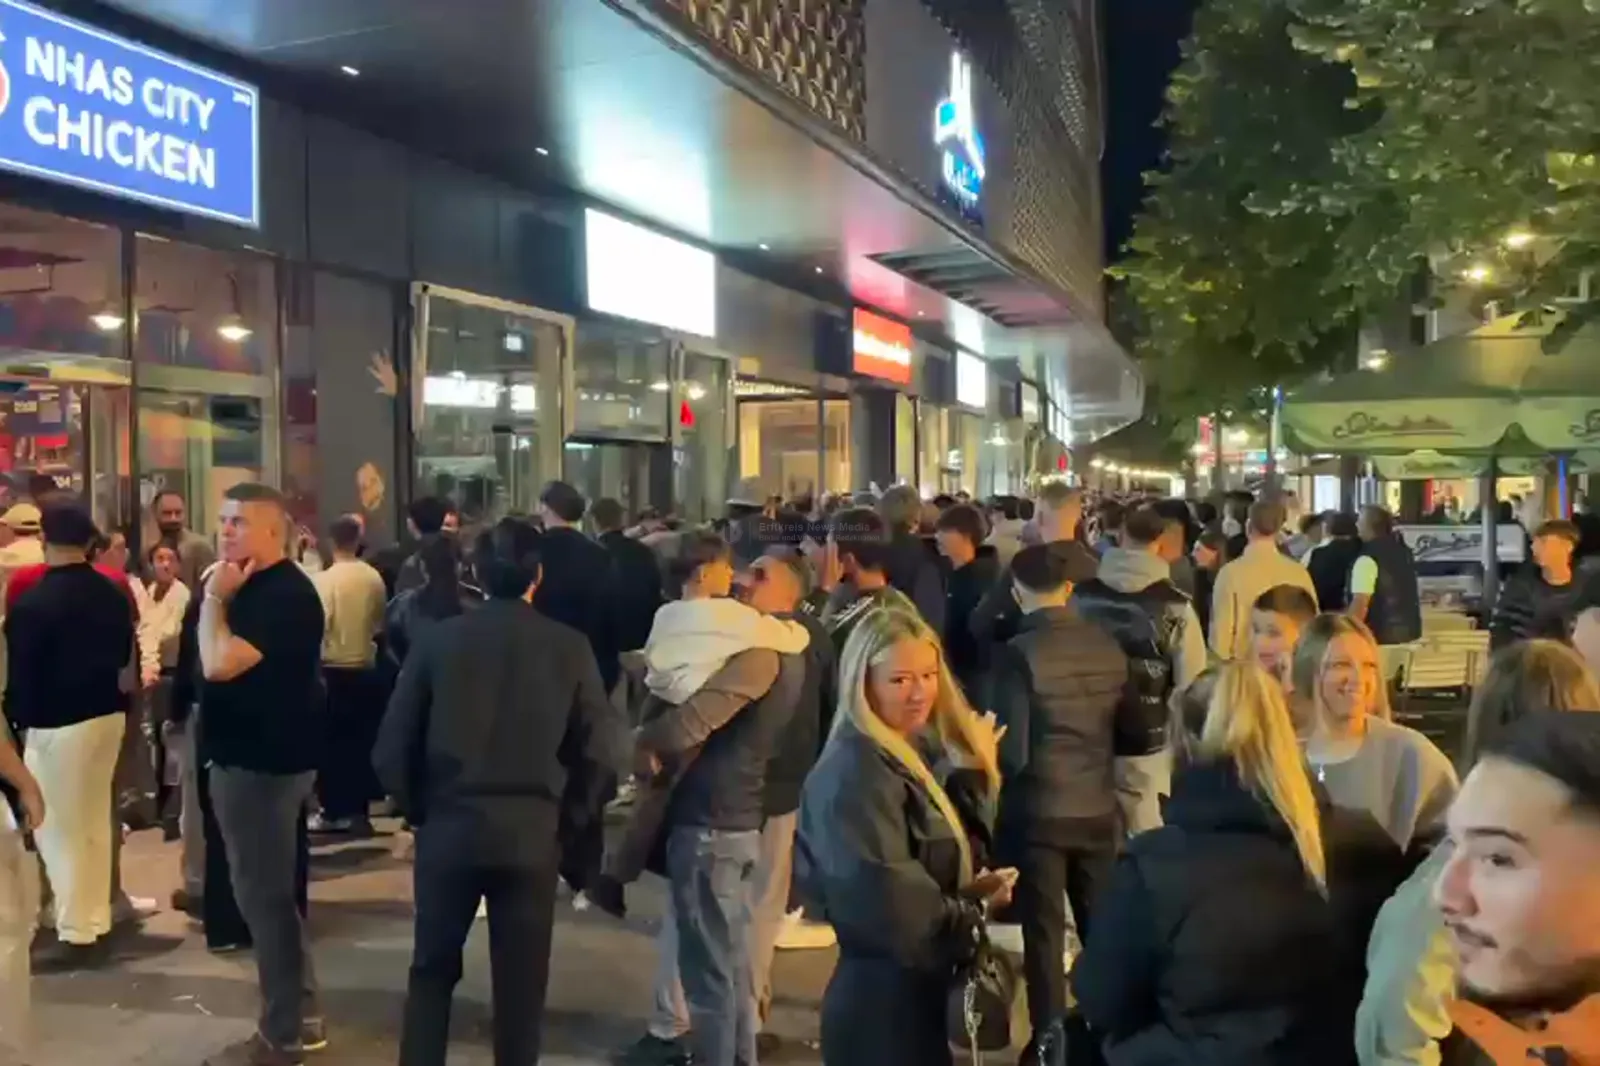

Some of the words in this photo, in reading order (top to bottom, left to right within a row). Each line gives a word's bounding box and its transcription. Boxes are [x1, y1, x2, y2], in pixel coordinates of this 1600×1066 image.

[25, 36, 133, 106] NHAS
[142, 77, 215, 131] CITY
[23, 95, 215, 189] CHICKEN
